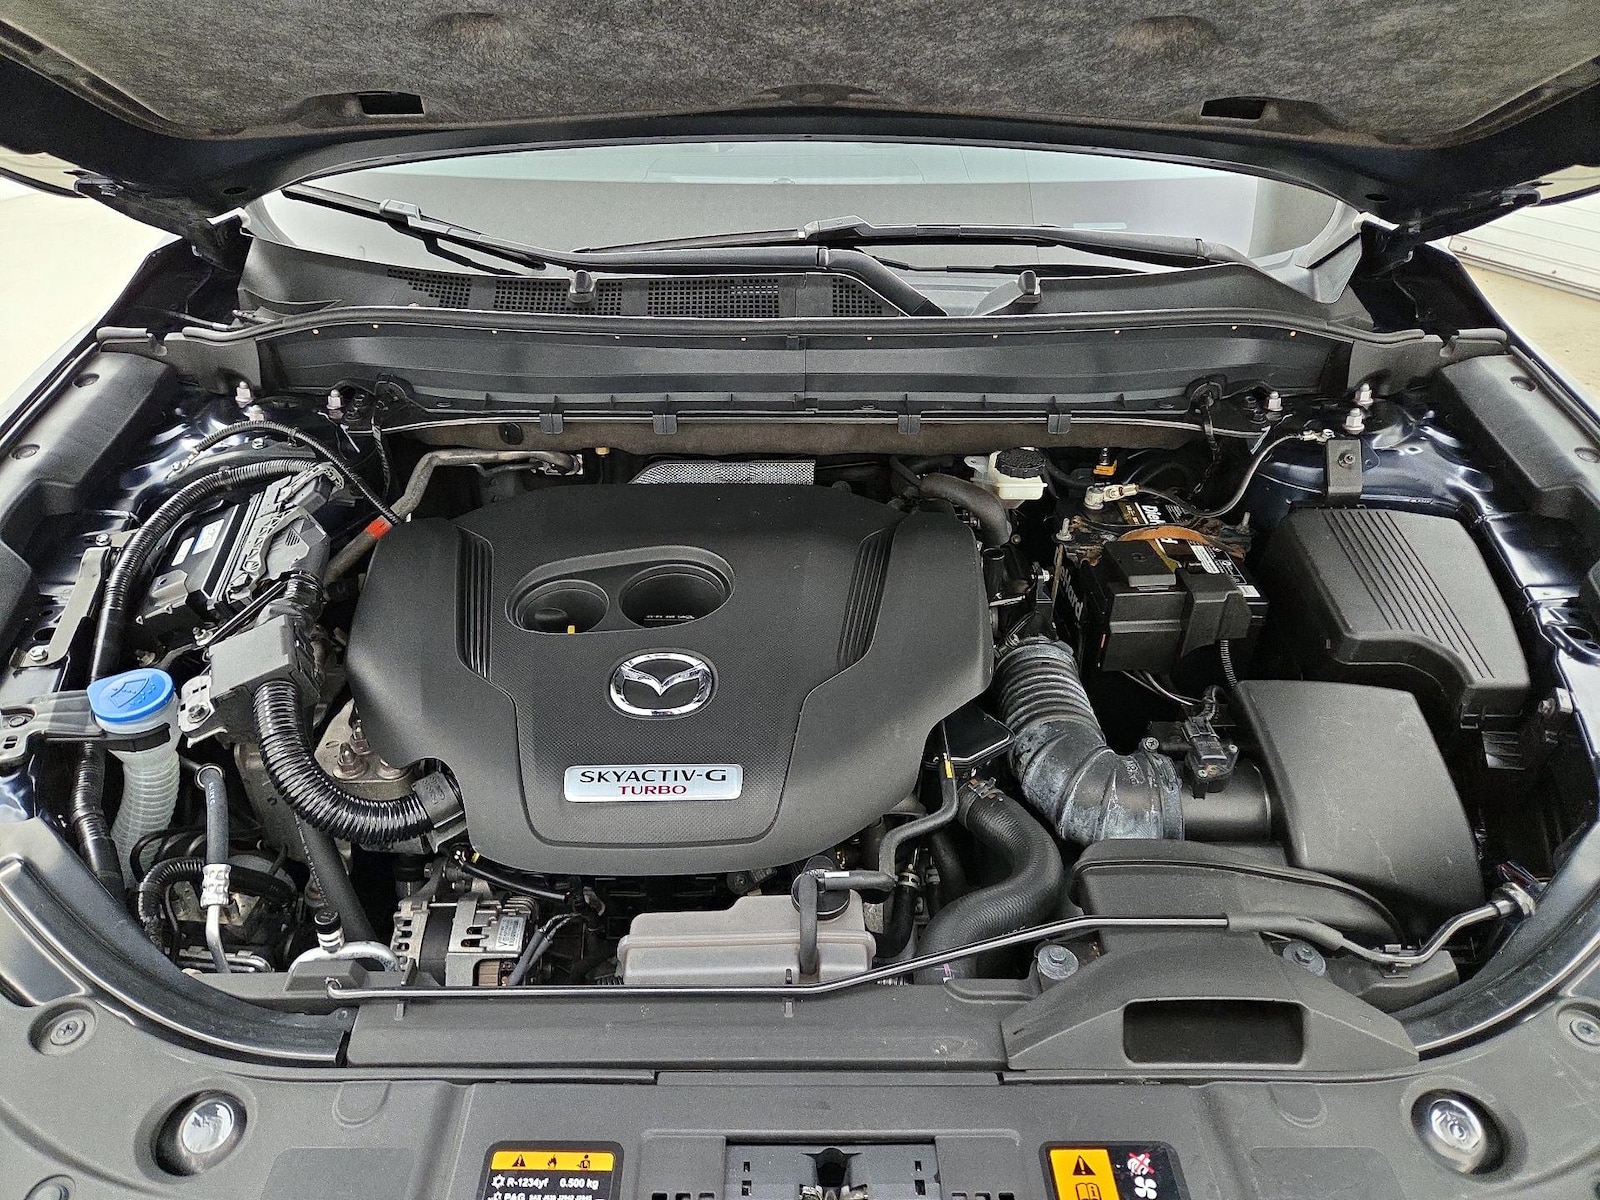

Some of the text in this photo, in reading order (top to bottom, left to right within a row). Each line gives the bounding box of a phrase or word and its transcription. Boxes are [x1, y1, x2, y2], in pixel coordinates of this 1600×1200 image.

[579, 769, 727, 783] SKYACTIV-G
[618, 784, 687, 795] TURBO
[506, 1177, 599, 1190] R-1234yf 0.500 kg
